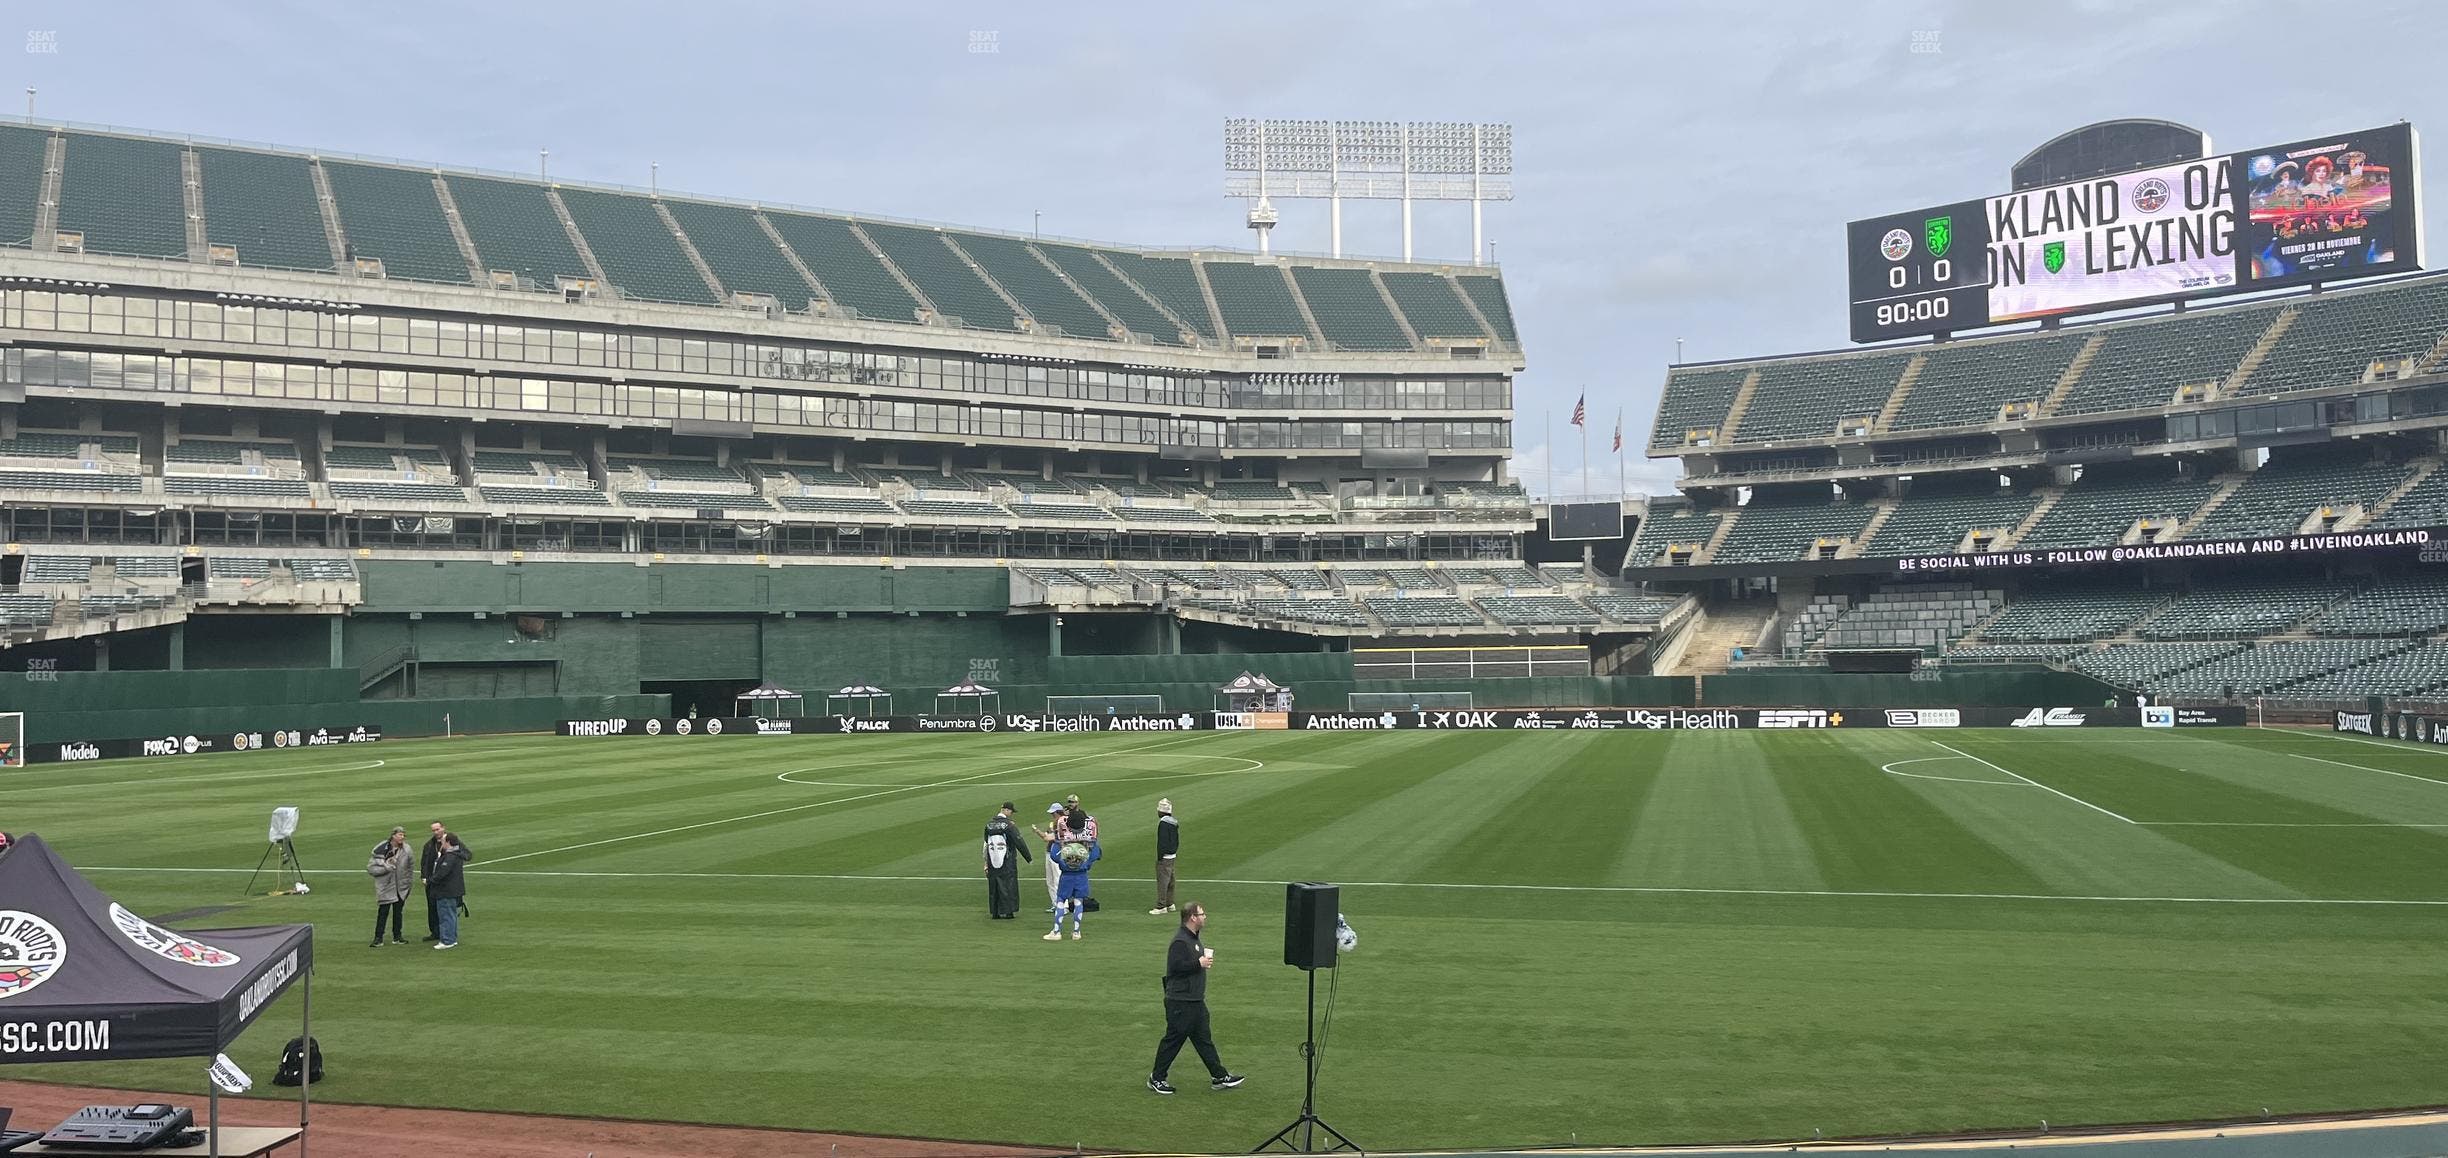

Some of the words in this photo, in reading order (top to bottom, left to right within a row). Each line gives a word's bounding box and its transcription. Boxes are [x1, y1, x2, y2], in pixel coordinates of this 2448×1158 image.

[2084, 209, 2235, 276] LEXING
[1889, 266, 1906, 288] 0
[1933, 259, 1951, 281] 0
[1877, 297, 1949, 326] 90:00
[1899, 559, 1916, 570] BE
[1920, 556, 1970, 568] SOCIAL
[1973, 555, 2009, 567] WITH
[2013, 553, 2032, 564] US
[2048, 550, 2107, 563] FOLLOW
[2111, 542, 2247, 562] @OAKLANDARENA
[2251, 540, 2284, 553] AND
[2290, 531, 2429, 551] #LIVEINOAKLAND
[567, 718, 628, 736] THREDUP
[856, 721, 890, 731] FALCK
[919, 718, 977, 729] Penumbra
[1006, 714, 1041, 732] UCSF
[1042, 714, 1100, 732] Health
[1108, 715, 1177, 731] Anthem
[1306, 714, 1379, 730] Anthem
[1417, 711, 1427, 728] I
[1455, 711, 1498, 728] OAK
[1513, 717, 1541, 729] Ava
[1571, 717, 1599, 729] Ava
[1626, 710, 1667, 729] UCSF
[1669, 709, 1739, 729] Health
[2337, 711, 2373, 735] SEATGEEK
[309, 734, 328, 746] Ava
[348, 732, 365, 743] Ava
[61, 743, 100, 761] Modelo
[11, 919, 58, 962] ROOTS
[0, 1019, 110, 1054] SC.COM
